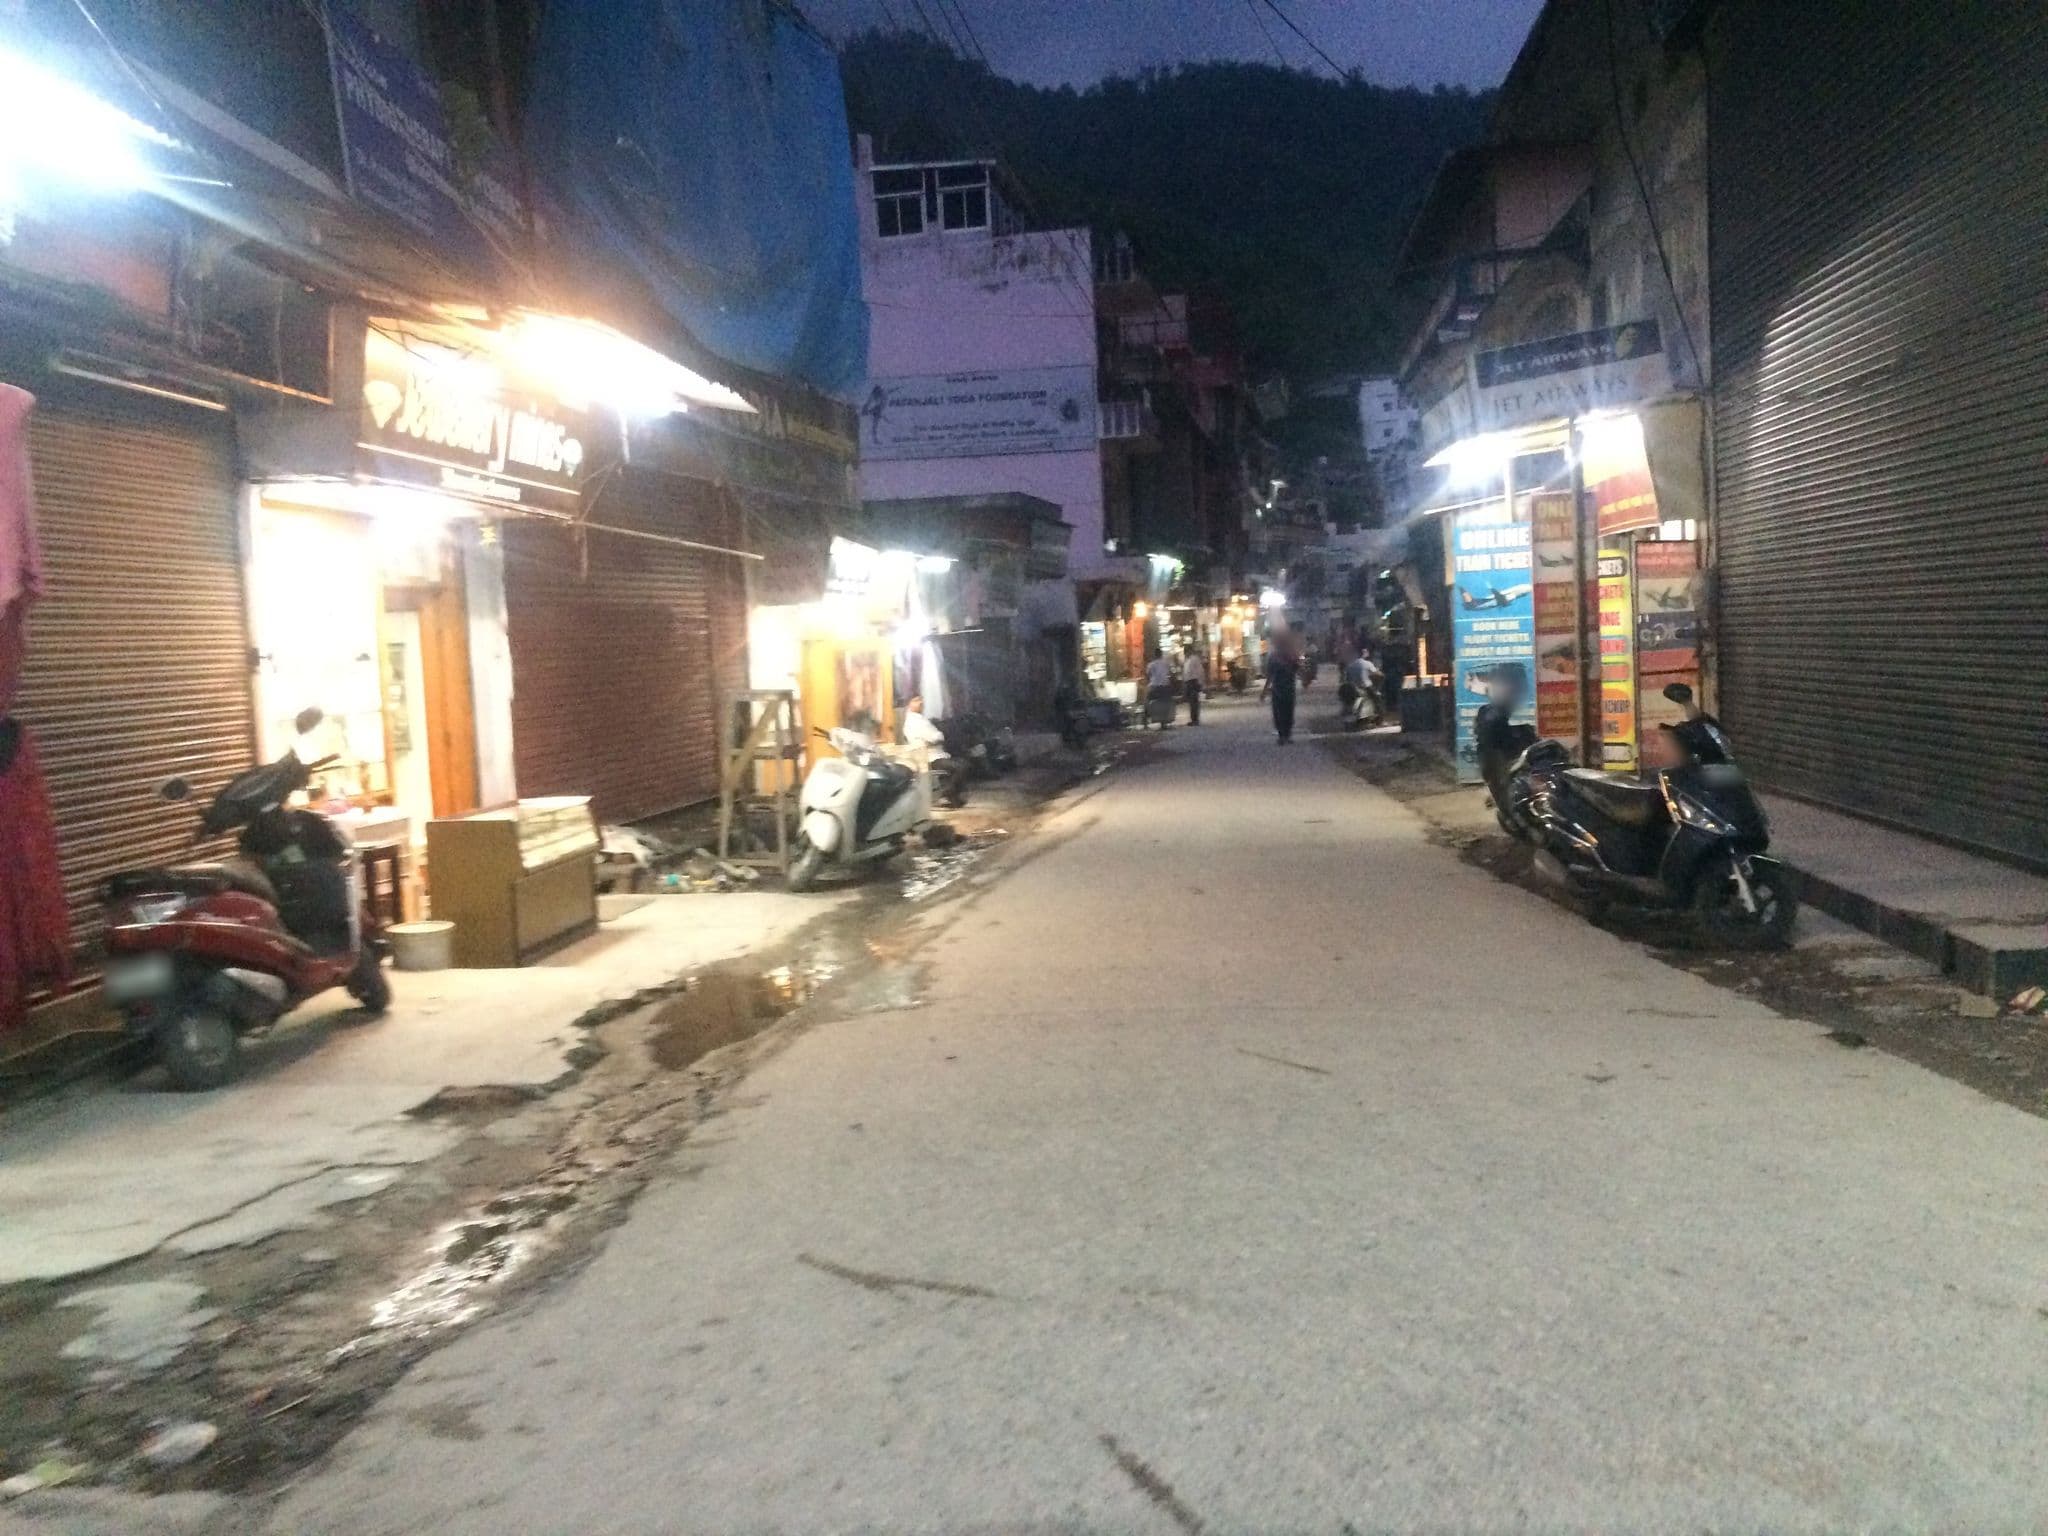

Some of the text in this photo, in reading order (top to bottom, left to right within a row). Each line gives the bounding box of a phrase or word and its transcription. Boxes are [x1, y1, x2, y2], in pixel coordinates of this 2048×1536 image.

[1530, 343, 1613, 367] AIRWAYS
[1493, 393, 1523, 414] JET
[1459, 527, 1530, 550] ONLINE
[1472, 622, 1497, 632] BOOK
